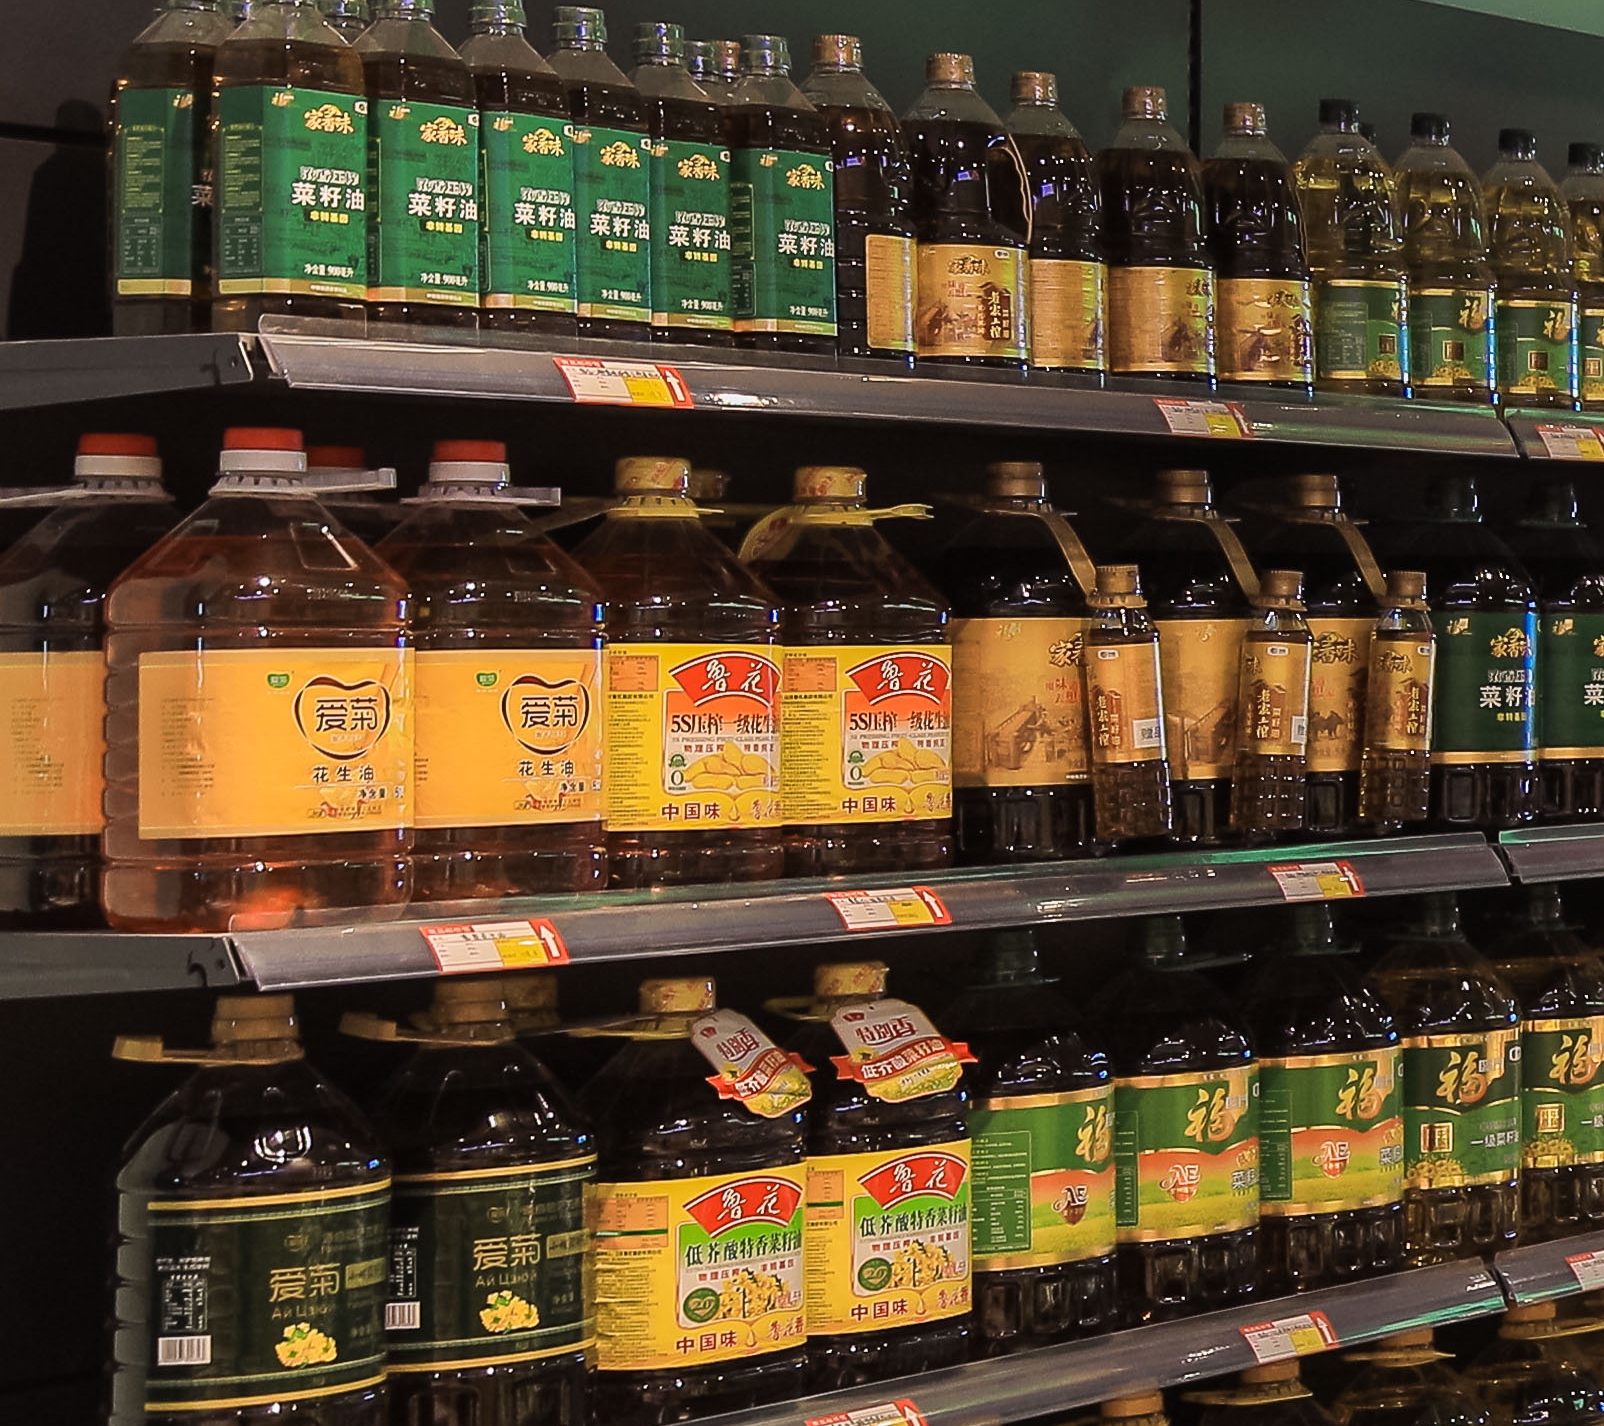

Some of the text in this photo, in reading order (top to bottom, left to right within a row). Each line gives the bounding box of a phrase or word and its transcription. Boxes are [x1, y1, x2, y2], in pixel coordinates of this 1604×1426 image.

[304, 104, 354, 134] 家香味
[419, 117, 468, 146] 家香味
[522, 128, 565, 157] 家香味
[600, 141, 640, 169] 家香味
[677, 154, 720, 181] 家香味
[786, 164, 825, 191] 家香味
[291, 181, 365, 211] 菜籽油
[408, 193, 478, 221] 菜籽油
[514, 202, 576, 229] 菜籽油
[590, 214, 650, 240] 菜籽油
[668, 225, 731, 252] 菜籽油
[778, 233, 835, 258] 菜籽油
[702, 659, 764, 694] 鲁花
[877, 659, 935, 692] 鲁花
[315, 696, 378, 732] 爱菊
[521, 696, 578, 729] 爱菊
[312, 765, 374, 784] 花生油
[519, 760, 574, 777] 花生油
[662, 803, 720, 821] 中国味
[842, 797, 895, 814] 中国味
[855, 1015, 918, 1045] 特别香
[717, 1029, 760, 1061] 特别香
[889, 1159, 948, 1194] 鲁花
[717, 1183, 780, 1220] 鲁花
[473, 1233, 541, 1272] 爱菊
[269, 1263, 340, 1303] 爱菊
[850, 1300, 908, 1322] 中国味
[675, 1330, 737, 1354] 中国味
